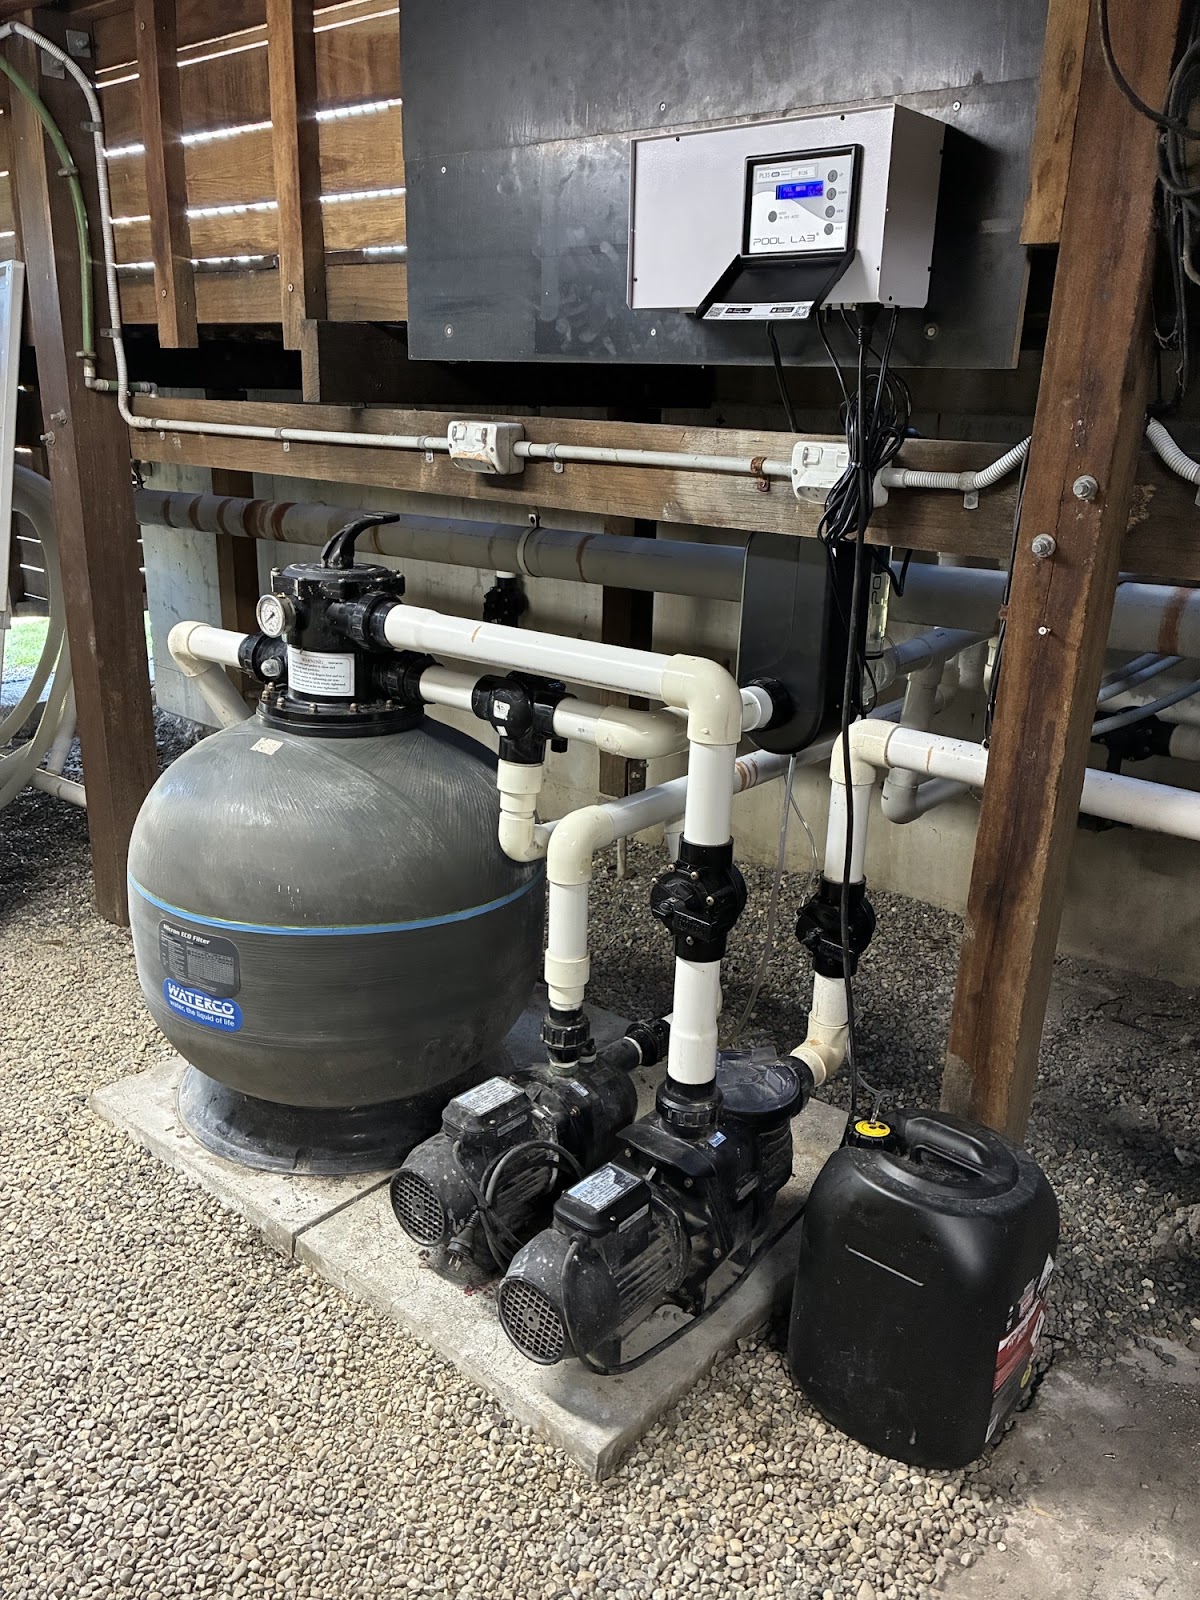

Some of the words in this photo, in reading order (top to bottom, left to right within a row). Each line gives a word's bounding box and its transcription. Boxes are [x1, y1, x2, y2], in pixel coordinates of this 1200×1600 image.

[753, 237, 785, 246] POOL
[872, 571, 881, 604] PO
[163, 923, 180, 936] Micron
[180, 931, 192, 940] ECO
[192, 935, 210, 945] Filter
[168, 982, 234, 1015] WATERCO
[196, 1010, 214, 1023] liquid
[215, 1017, 223, 1025] of
[223, 1018, 235, 1027] life
